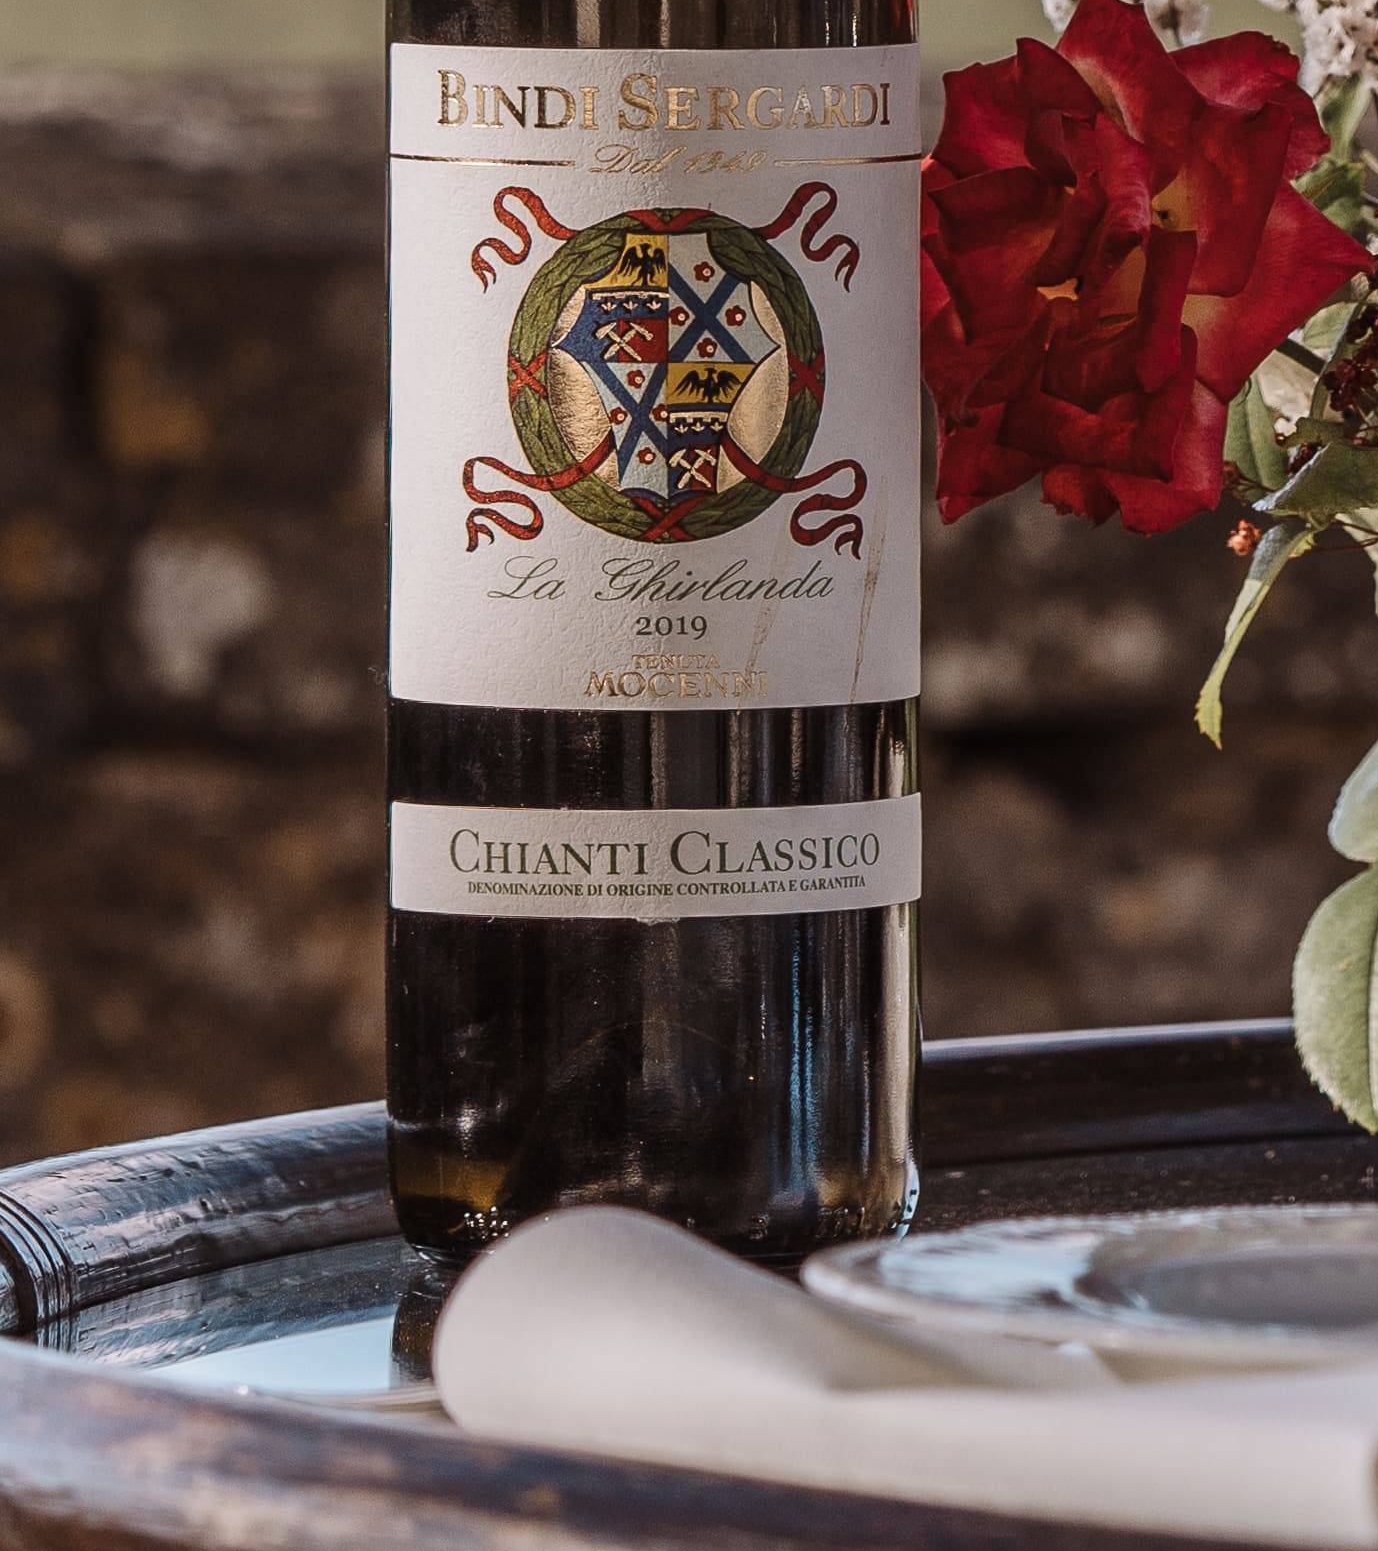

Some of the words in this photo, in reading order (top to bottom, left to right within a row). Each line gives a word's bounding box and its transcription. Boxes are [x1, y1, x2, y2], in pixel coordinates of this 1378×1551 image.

[436, 68, 600, 131] BINDI
[617, 71, 892, 132] SERGARDI
[589, 143, 688, 175] Dal
[486, 555, 566, 601] La
[593, 556, 835, 603] Ghirlanda
[635, 615, 709, 641] 2019
[631, 653, 721, 670] TENUTA
[583, 668, 769, 699] MOCENNI
[448, 828, 648, 876] CHIANTI
[668, 829, 881, 876] CLASSICO
[467, 880, 585, 897] DENOMINAZIONE
[586, 882, 604, 897] DI
[606, 882, 675, 897] ORIGINE
[676, 880, 786, 896] CONTROLLATA
[787, 879, 798, 893] E
[799, 874, 867, 892] GARANTITA
